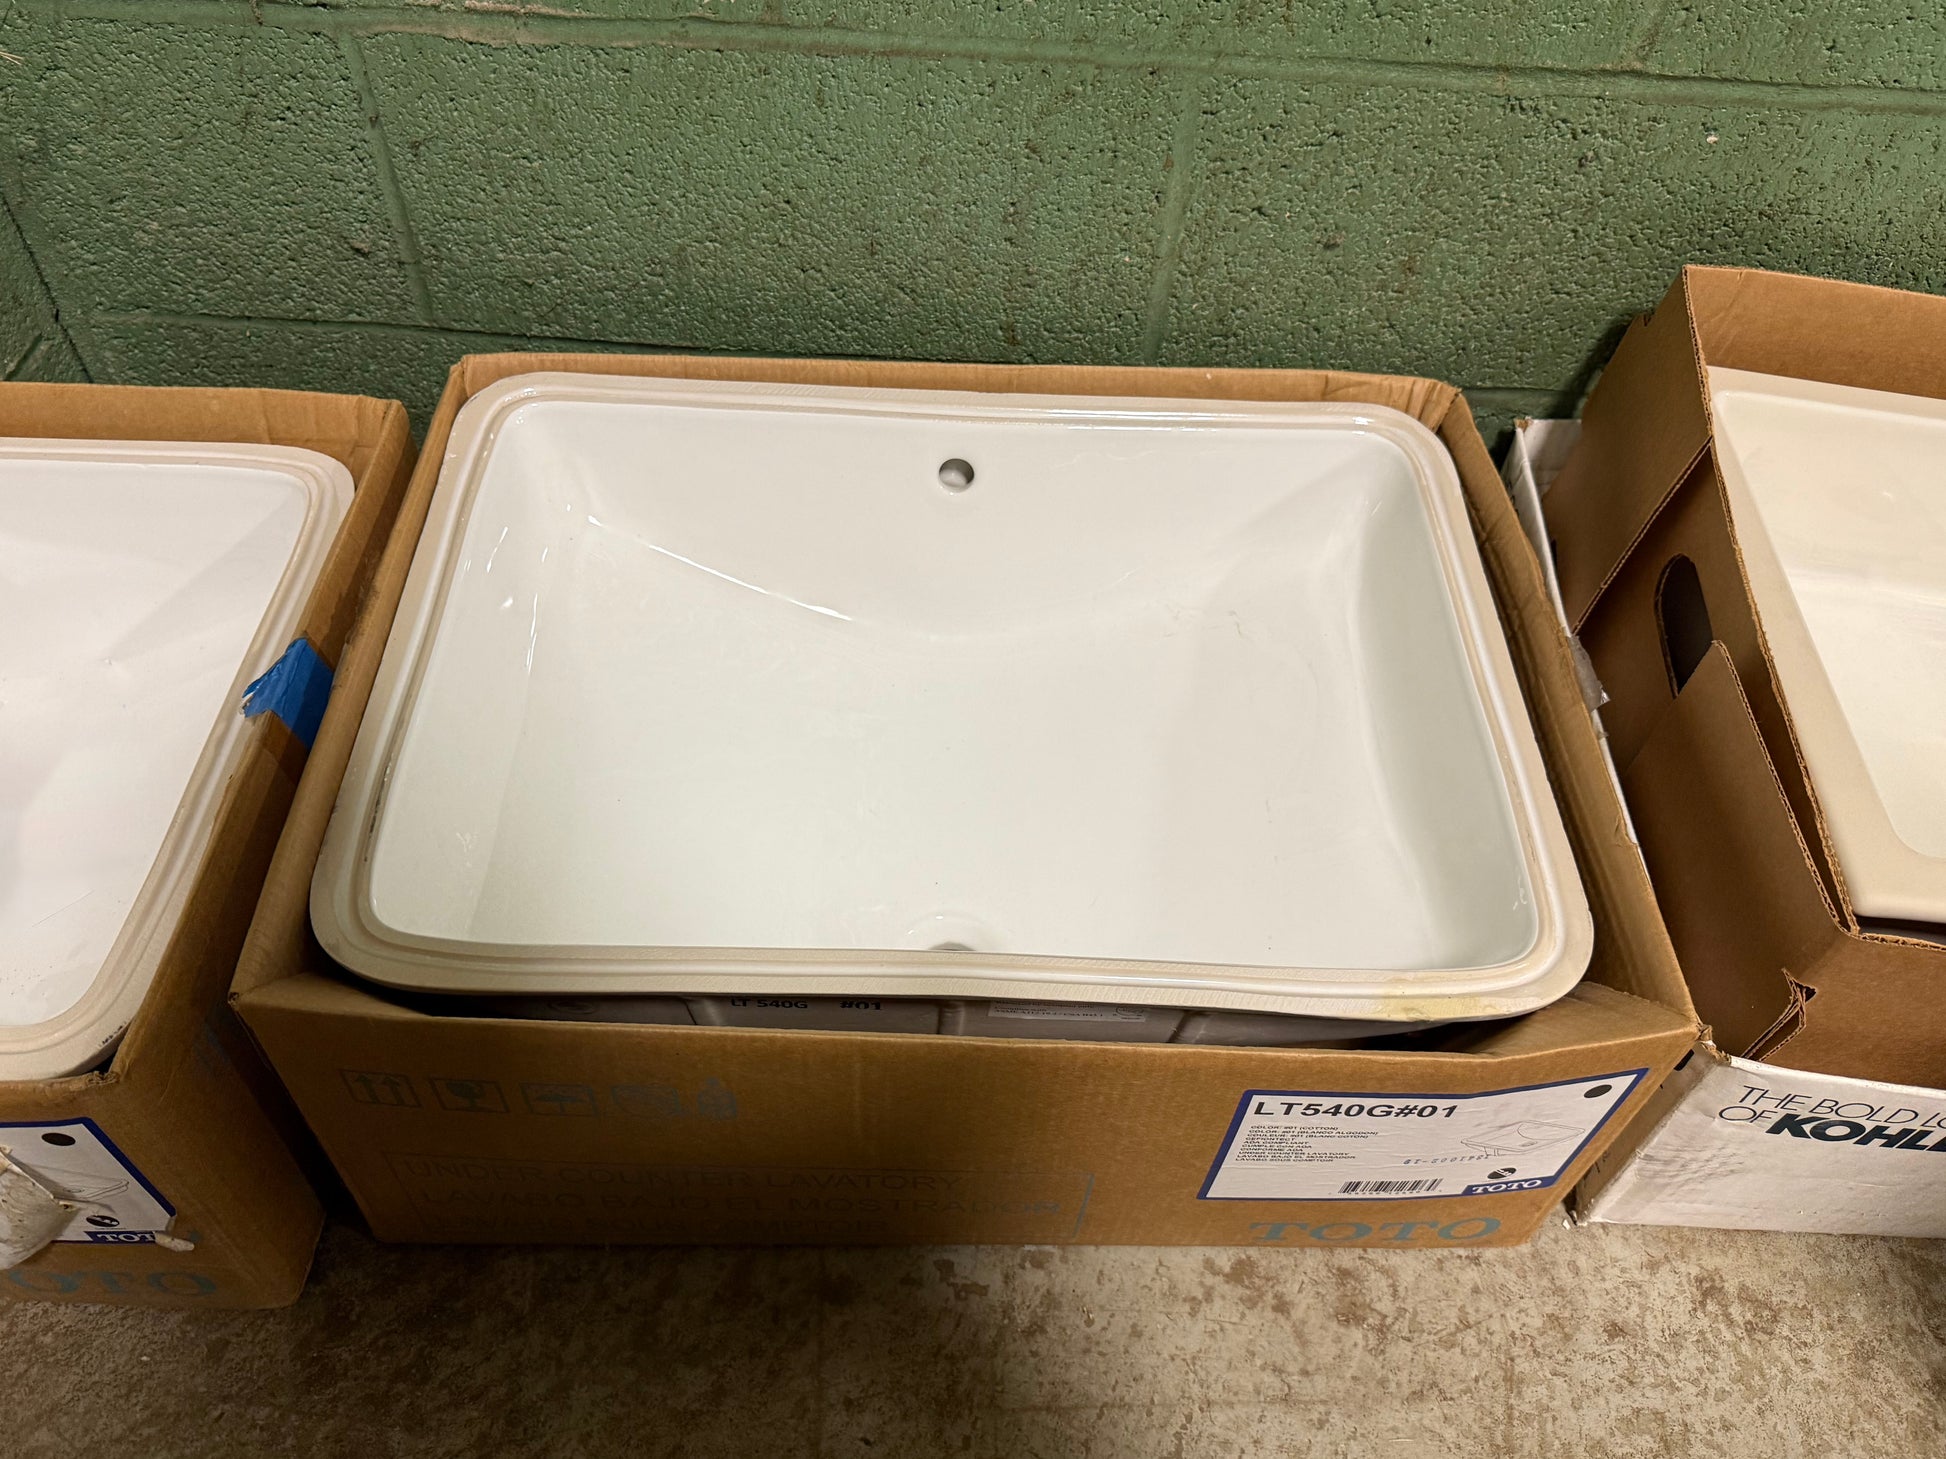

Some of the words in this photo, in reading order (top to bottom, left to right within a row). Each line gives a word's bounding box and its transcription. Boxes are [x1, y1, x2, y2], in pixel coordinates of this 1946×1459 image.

[730, 998, 748, 1008] LT
[756, 999, 809, 1010] 540G
[839, 1000, 882, 1011] #01
[1253, 1102, 1459, 1118] LT540G#01
[1719, 1105, 1778, 1123] OF
[1738, 1085, 1813, 1111] THE
[1809, 1098, 1919, 1124] BOLD
[1921, 1111, 1946, 1130] L
[556, 1167, 752, 1188] COUNTER
[766, 1173, 963, 1191] LAVATORY
[1471, 1178, 1543, 1194] TOTO
[1251, 1216, 1501, 1242] TOTO
